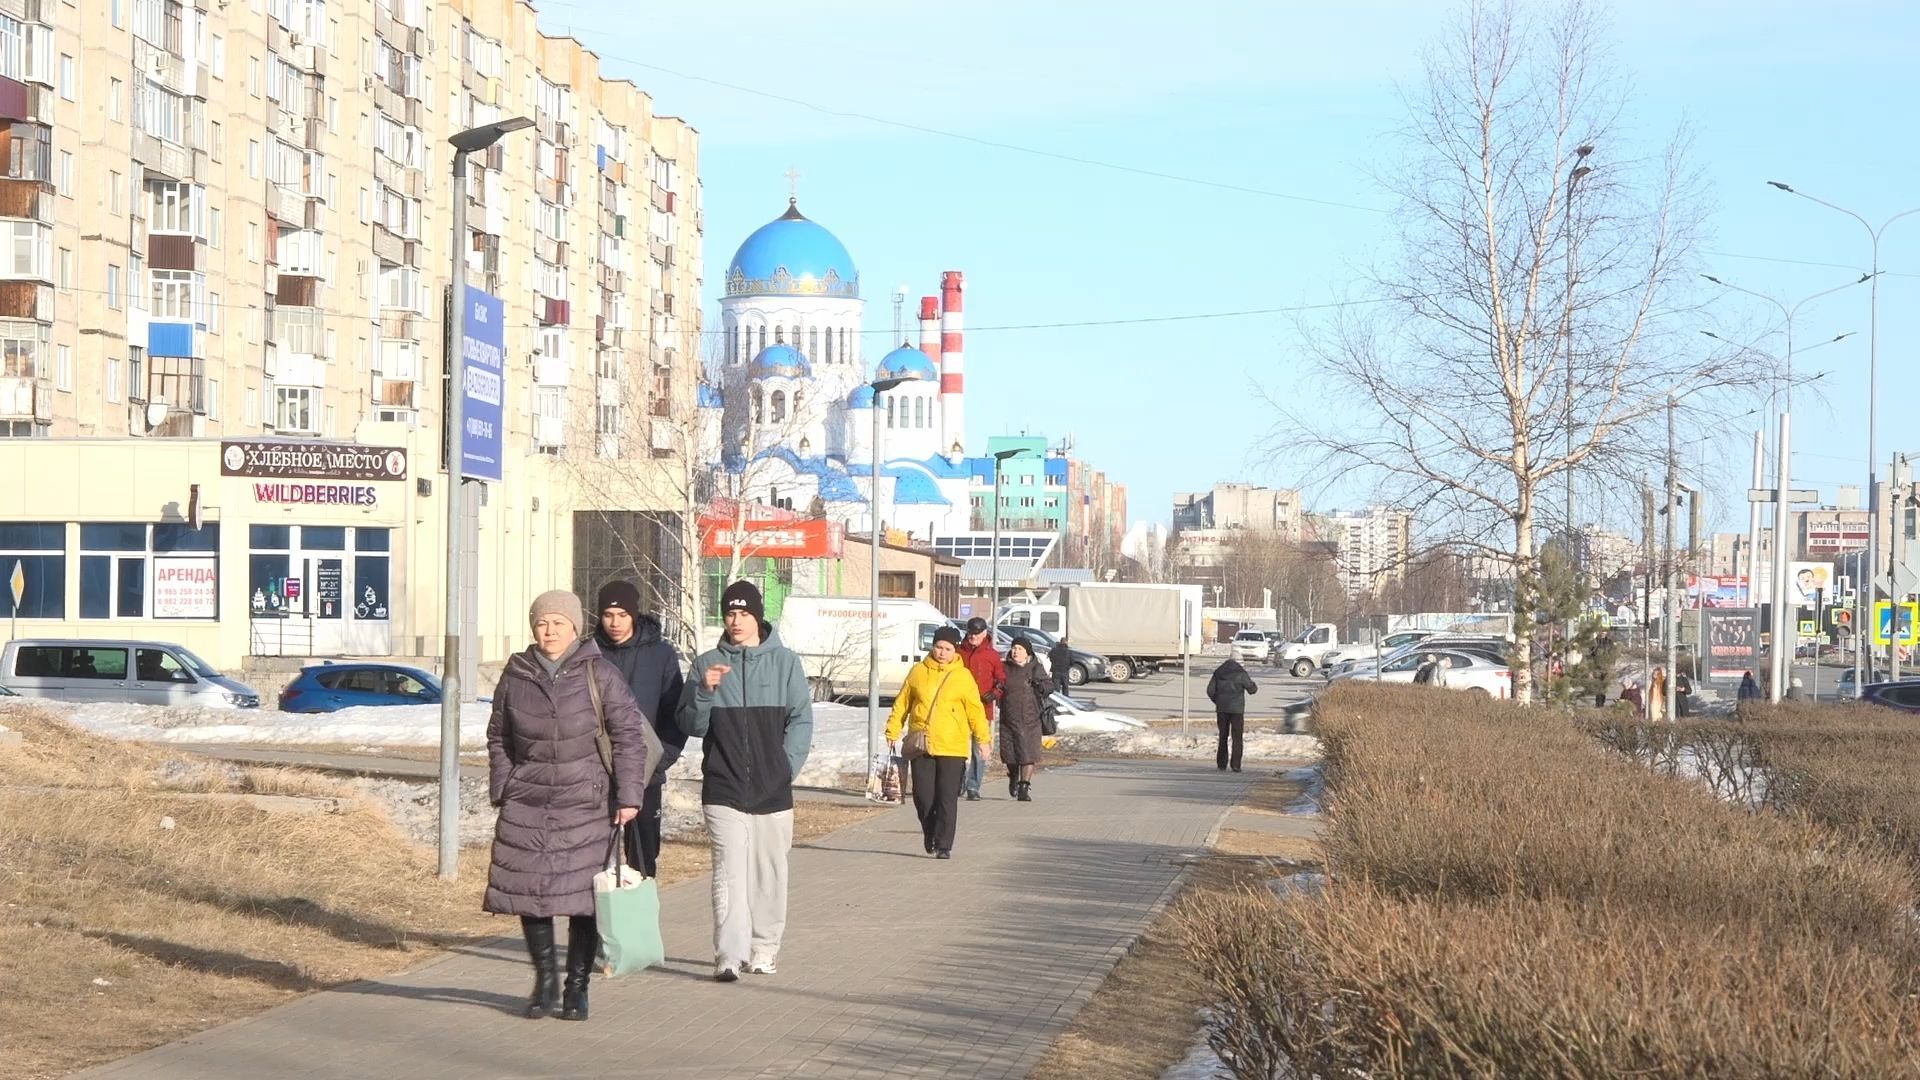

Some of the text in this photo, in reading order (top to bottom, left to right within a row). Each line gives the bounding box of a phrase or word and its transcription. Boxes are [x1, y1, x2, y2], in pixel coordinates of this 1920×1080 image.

[248, 451, 383, 470] ХЛЕБНОЕ МЕСТО
[254, 483, 377, 506] WILDBERRIES
[158, 568, 217, 584] АРЕНДА
[729, 598, 747, 607] FILA
